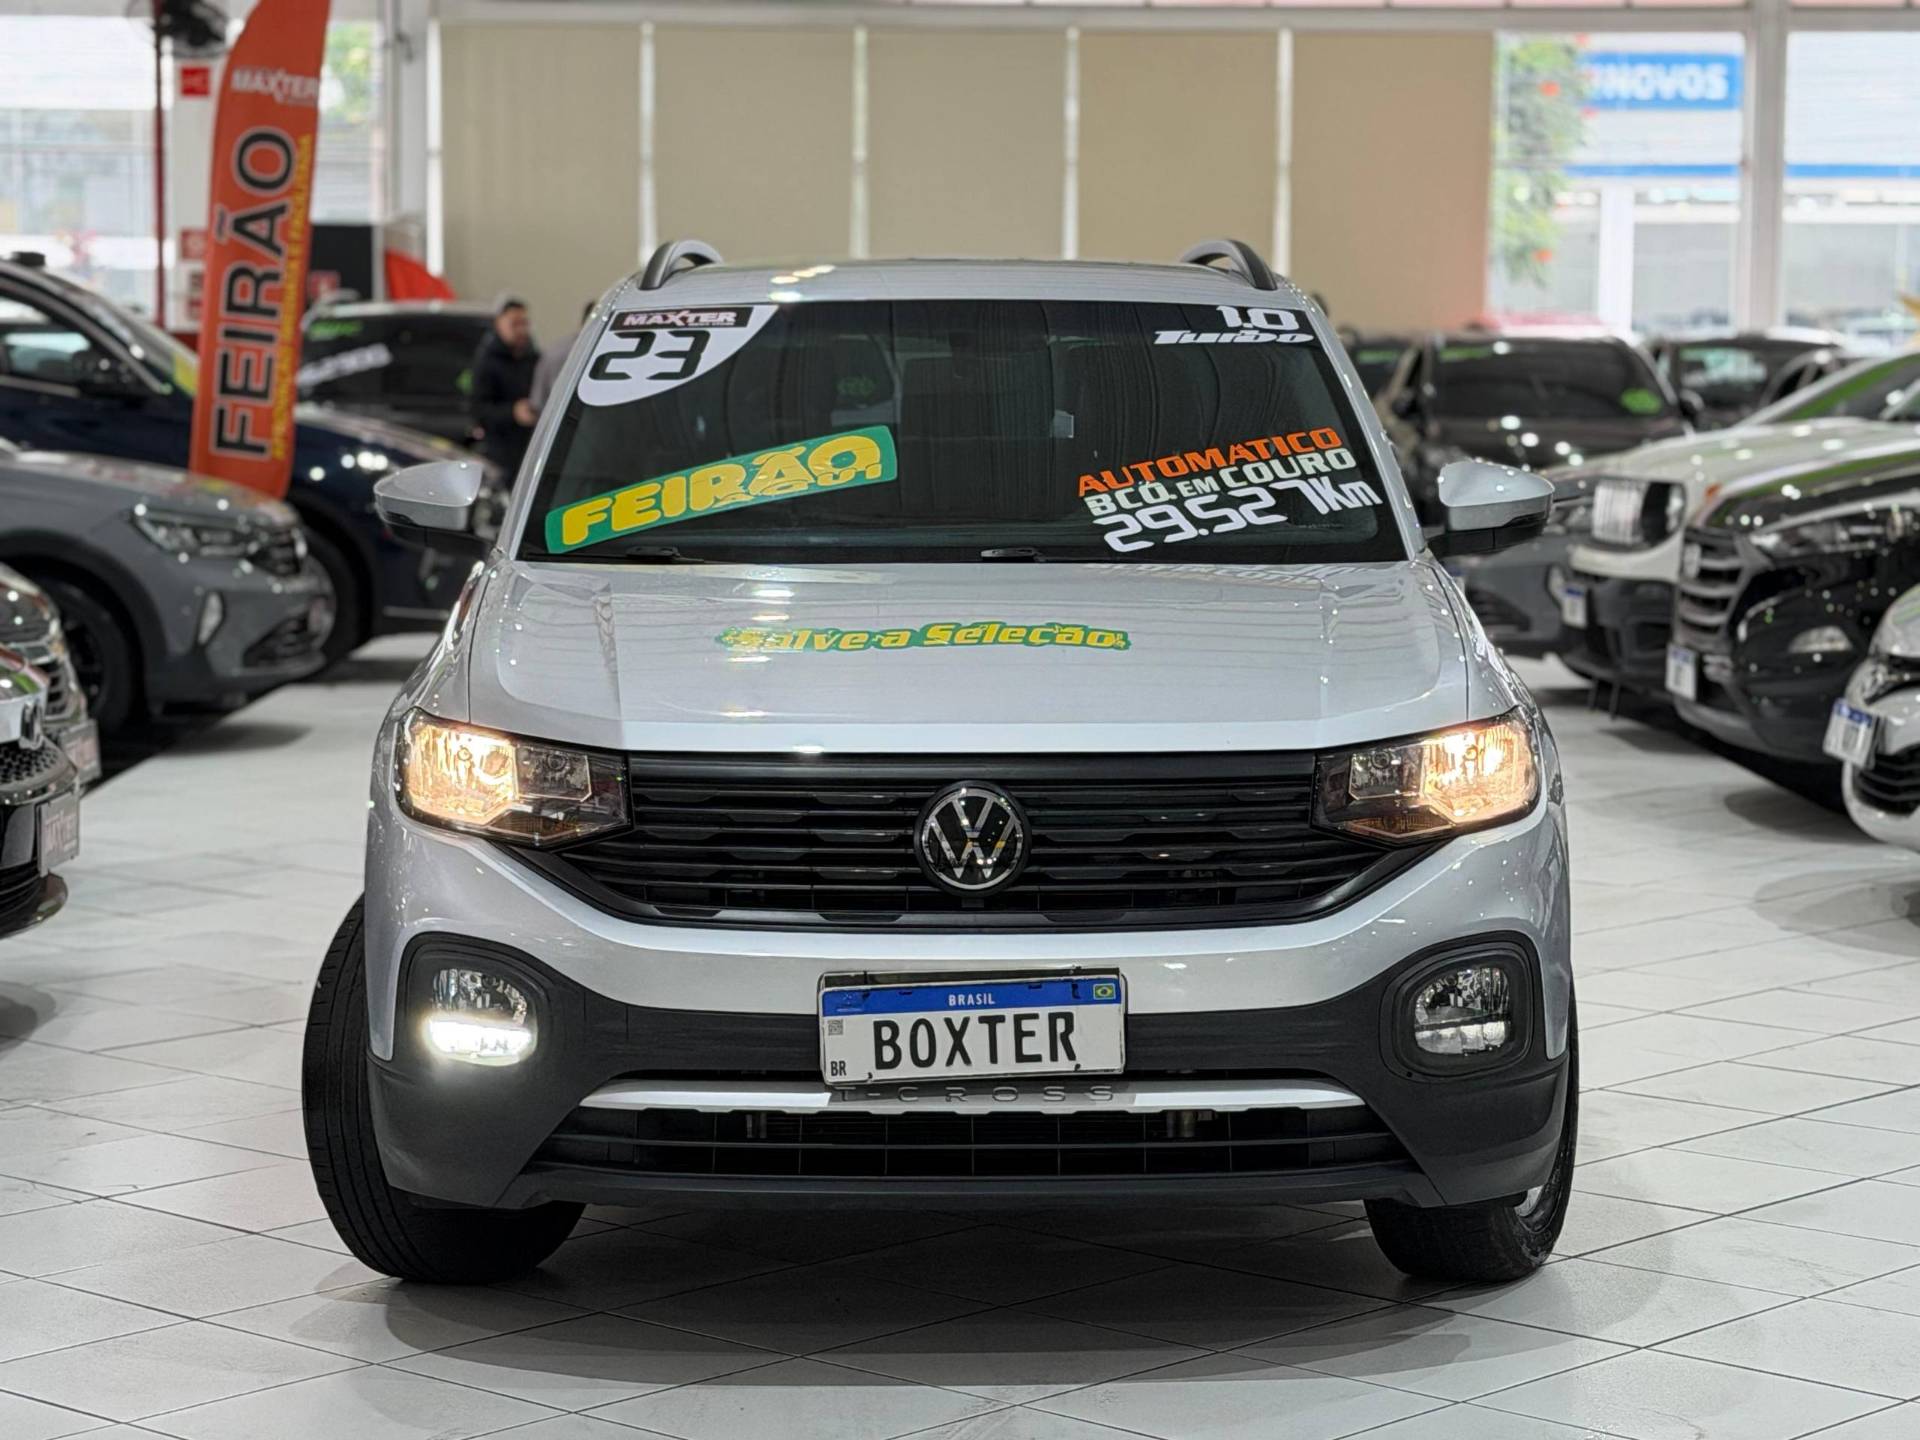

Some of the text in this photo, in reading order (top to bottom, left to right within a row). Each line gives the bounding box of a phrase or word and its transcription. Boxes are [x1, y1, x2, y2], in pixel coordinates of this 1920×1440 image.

[210, 127, 295, 461] FEIRÃO
[623, 310, 738, 327] MAXTER
[1216, 305, 1299, 331] 1.0
[1154, 330, 1314, 345] Turbo
[589, 330, 711, 382] 23
[1175, 475, 1221, 498] EM
[1218, 447, 1357, 489] COURO
[561, 435, 883, 546] FEIRÃO
[924, 622, 1115, 648] Seleção
[947, 993, 996, 1007] BRASIL
[872, 1011, 1077, 1071] BOXTER
[830, 1060, 847, 1077] BR
[834, 1085, 1114, 1103] T-CROSS
